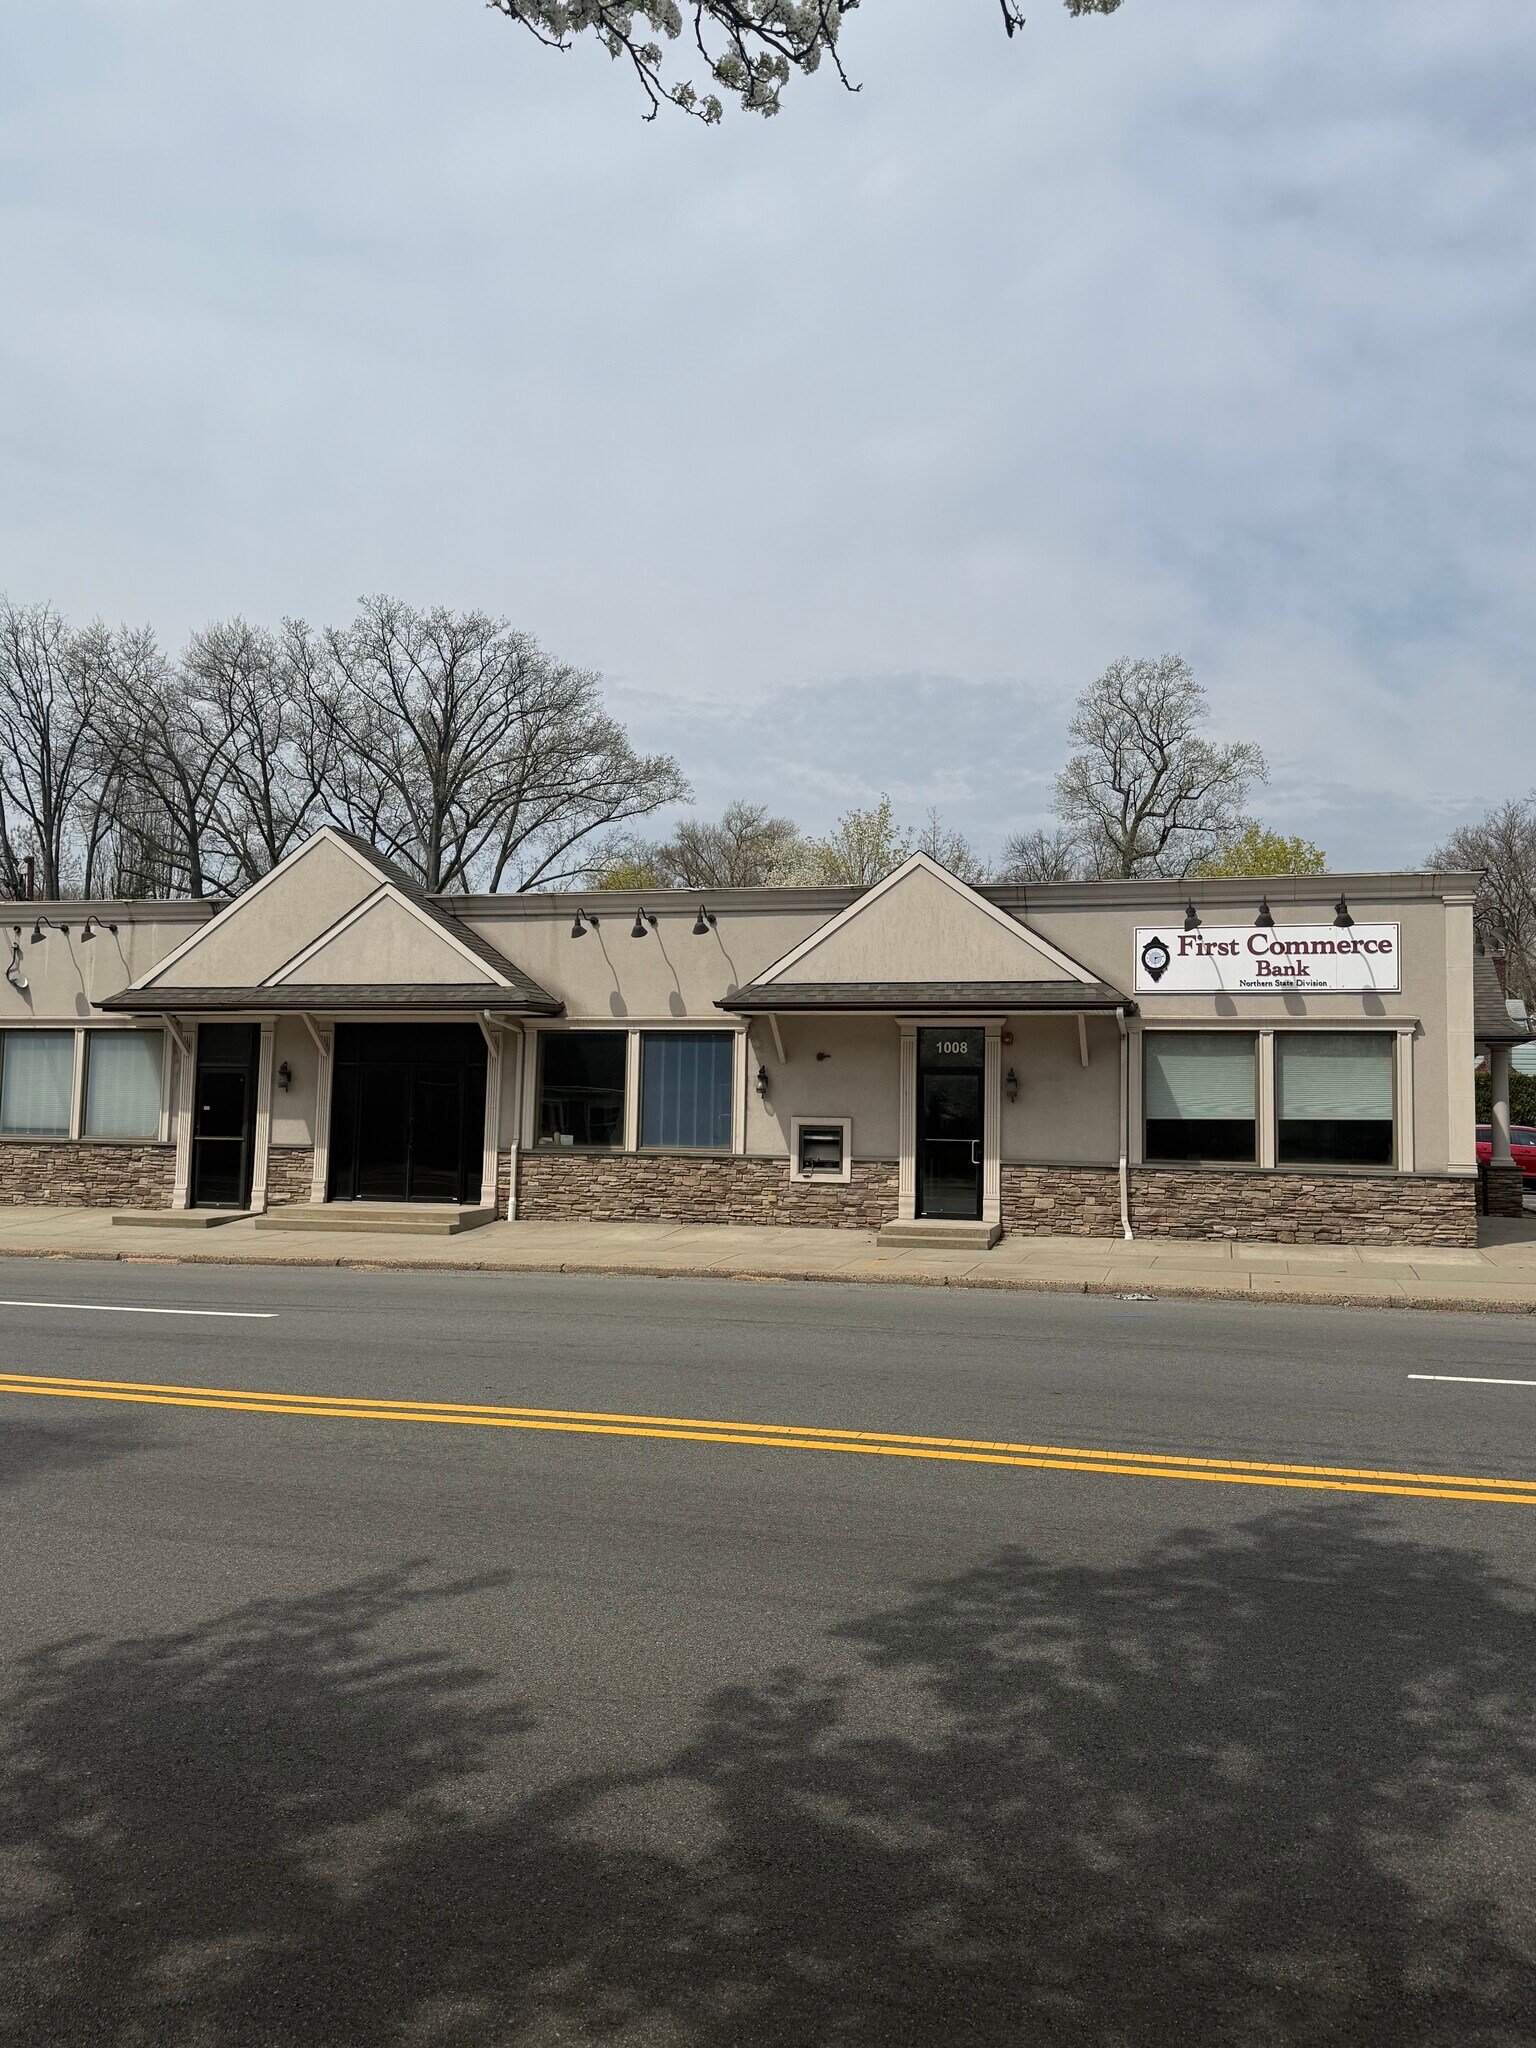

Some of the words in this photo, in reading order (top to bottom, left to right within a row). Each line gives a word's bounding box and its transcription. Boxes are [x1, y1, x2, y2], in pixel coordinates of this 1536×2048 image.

[1177, 934, 1239, 956] First
[1247, 933, 1393, 955] Commerce
[1255, 959, 1310, 977] Bank
[1239, 979, 1273, 987] Northern
[1274, 979, 1294, 987] State
[1296, 979, 1327, 987] Division
[936, 1041, 968, 1053] 1008
